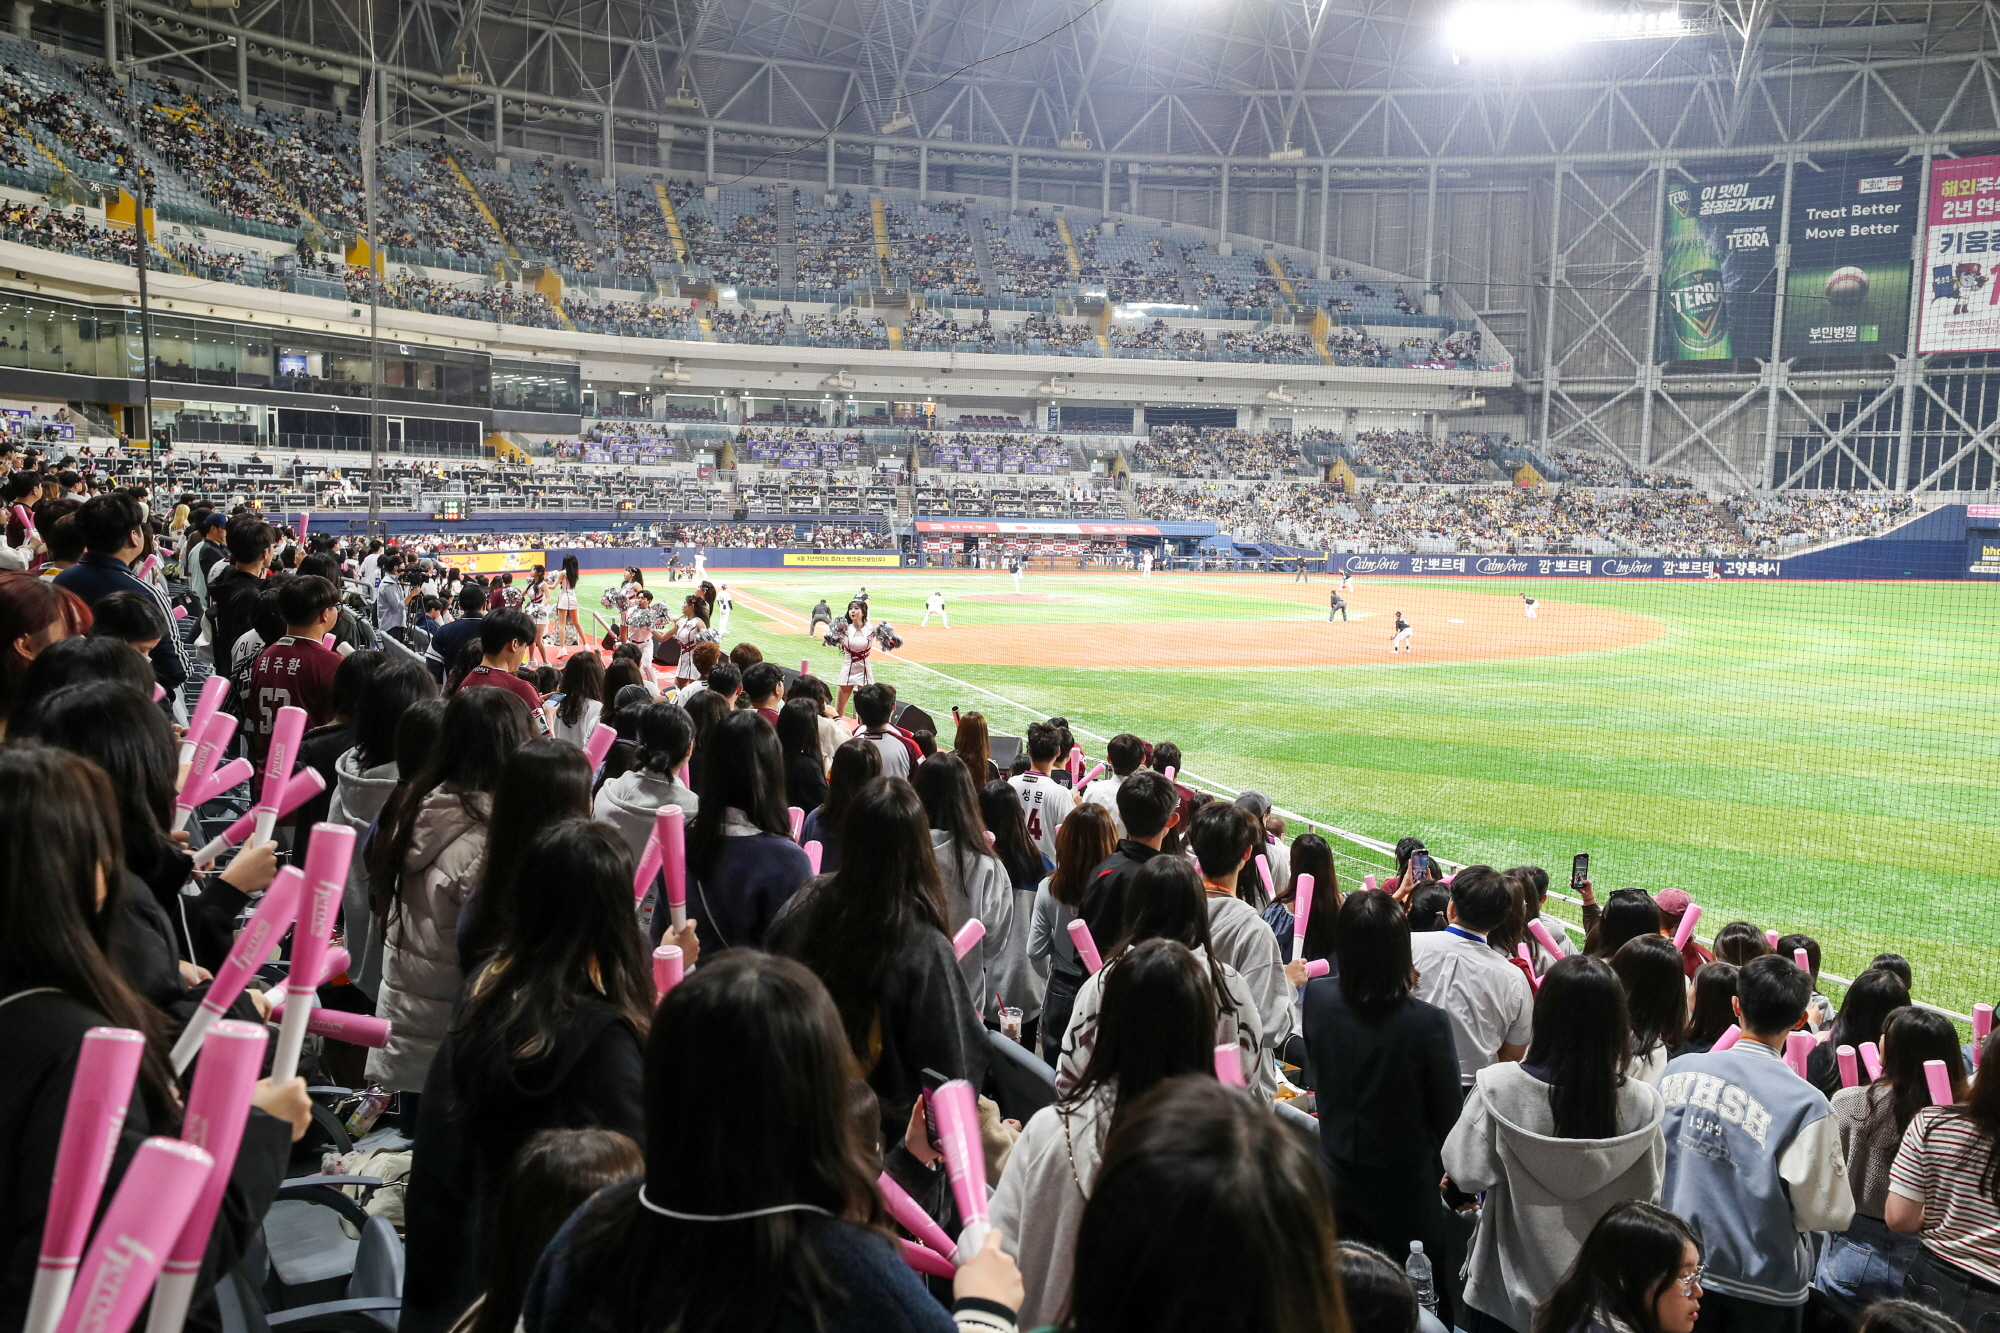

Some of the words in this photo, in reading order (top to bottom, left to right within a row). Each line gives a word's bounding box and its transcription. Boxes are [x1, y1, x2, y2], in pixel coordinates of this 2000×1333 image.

[90, 182, 100, 192] 26
[1701, 186, 1717, 200] 이
[1718, 183, 1749, 199] 맛이
[1806, 207, 1847, 220] Treat
[1852, 204, 1901, 216] Better
[1942, 200, 1973, 219] 2년
[333, 231, 341, 239] 27
[1805, 228, 1846, 239] Move
[1850, 223, 1900, 236] Better
[1726, 232, 1770, 249] TERRA
[1809, 326, 1857, 340] 부민병원
[1724, 561, 1780, 576] 고양특례시
[266, 743, 286, 779] heroes
